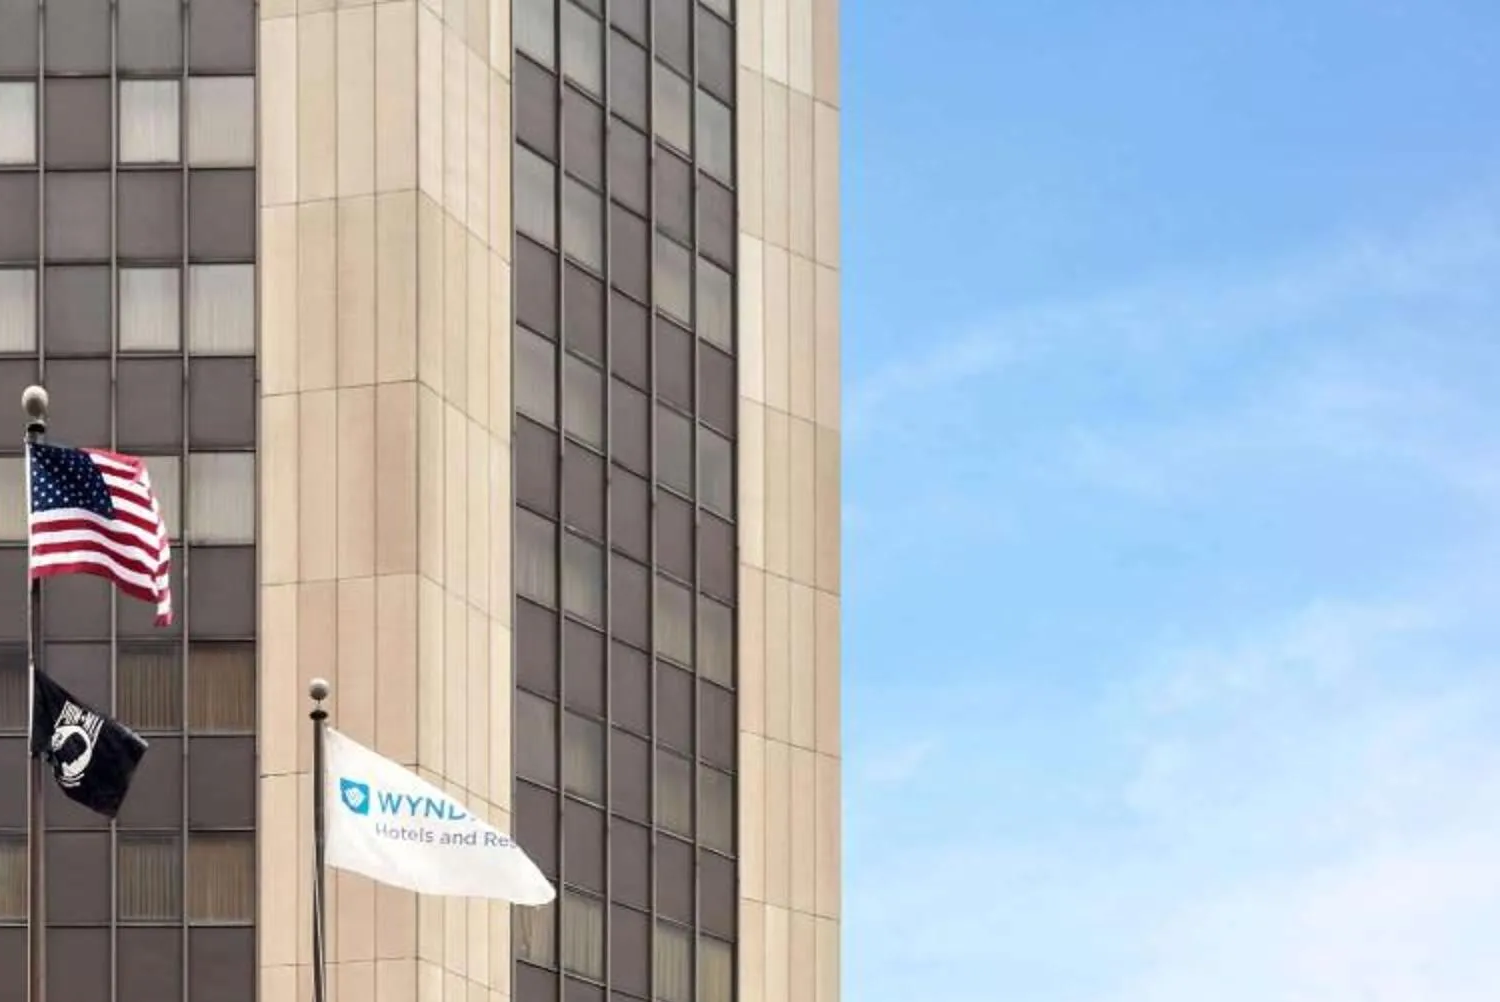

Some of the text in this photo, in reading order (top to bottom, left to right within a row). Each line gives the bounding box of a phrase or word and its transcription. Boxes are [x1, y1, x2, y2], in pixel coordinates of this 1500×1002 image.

[376, 790, 475, 822] WYND
[375, 822, 434, 844] Hotels
[440, 831, 477, 847] and
